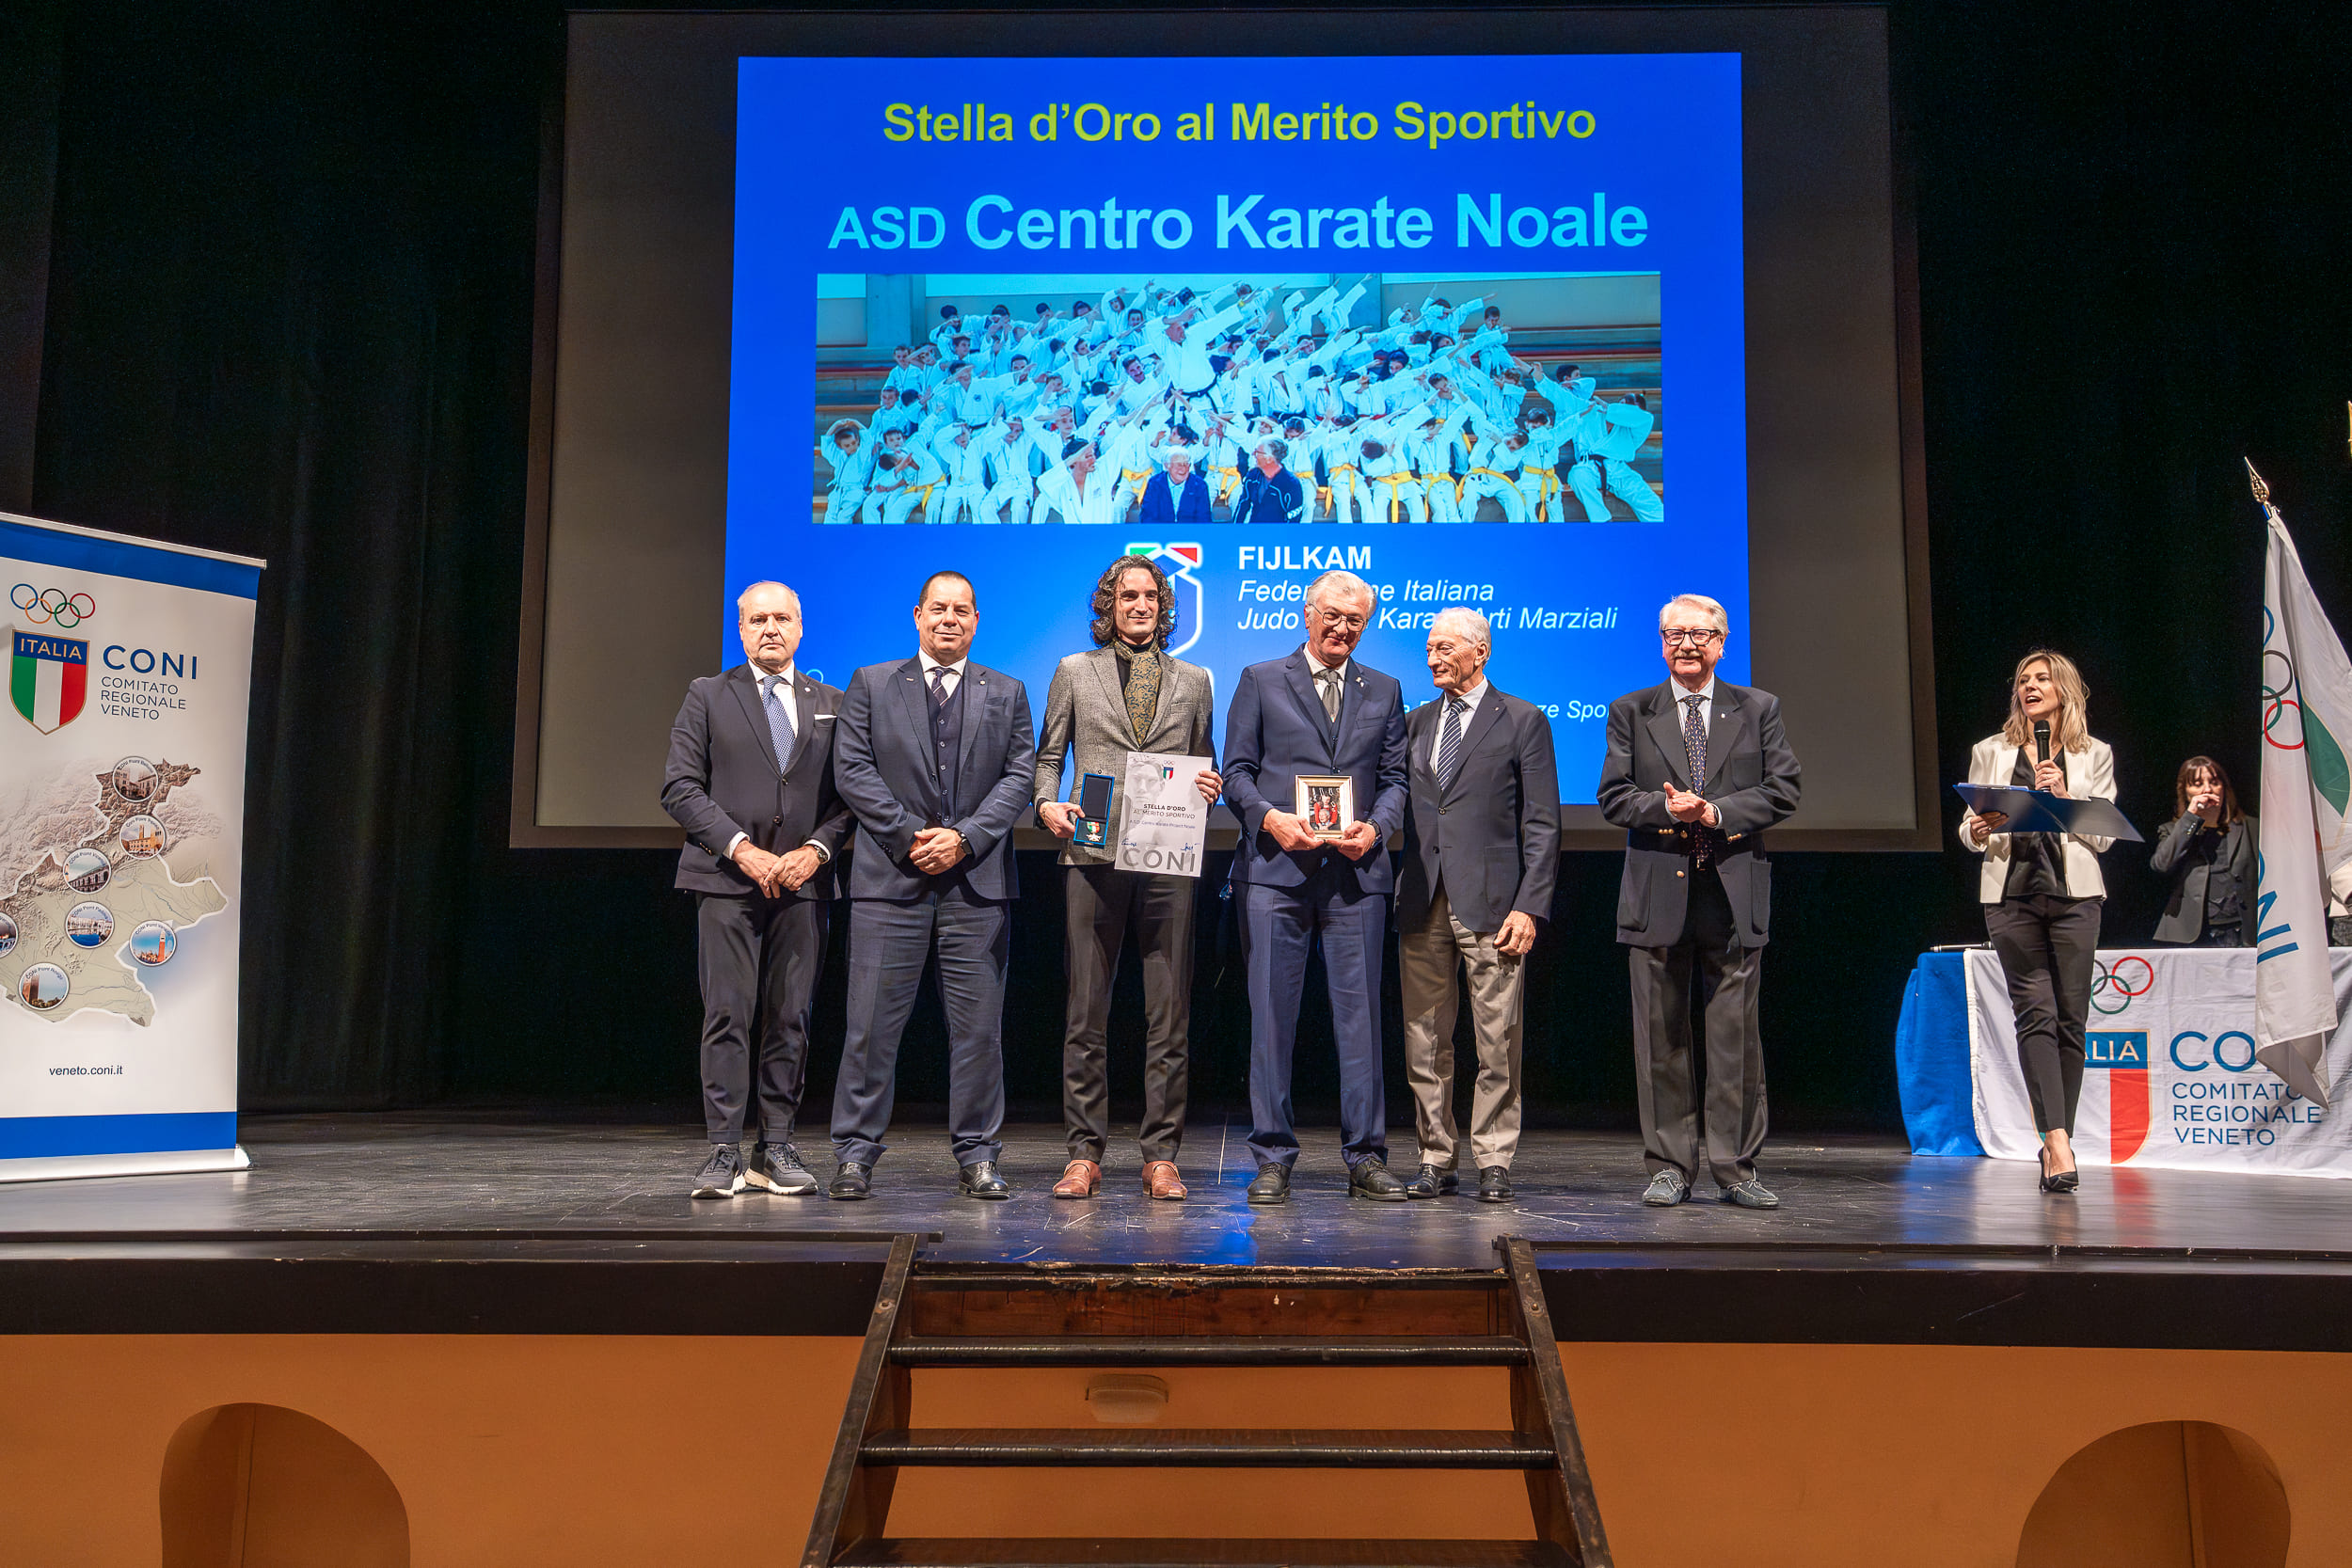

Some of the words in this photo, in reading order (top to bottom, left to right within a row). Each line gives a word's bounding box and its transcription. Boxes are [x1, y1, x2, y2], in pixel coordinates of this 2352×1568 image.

[885, 103, 1013, 141] Stella
[1177, 103, 1214, 141] al
[1232, 103, 1378, 141] Merito
[1394, 101, 1596, 150] Sportivo
[828, 206, 946, 250] ASD
[965, 194, 1194, 250] Centro
[1216, 194, 1434, 250] Karate
[1457, 192, 1648, 248] Noale
[1238, 546, 1371, 570] FIJLKAM
[1404, 579, 1494, 602] Italiana
[1237, 608, 1299, 630] Judo
[1518, 607, 1618, 629] Marziali
[20, 638, 83, 659] ITALIA
[103, 644, 198, 680] CONI
[101, 675, 179, 695] COMITATO
[101, 689, 186, 710] REGIONALE
[101, 704, 160, 721] VENETO
[1122, 847, 1196, 873] CONI
[49, 1065, 123, 1076] veneto.coni.it
[2172, 1104, 2323, 1124] REGIONALE
[2174, 1127, 2276, 1147] VENETO
